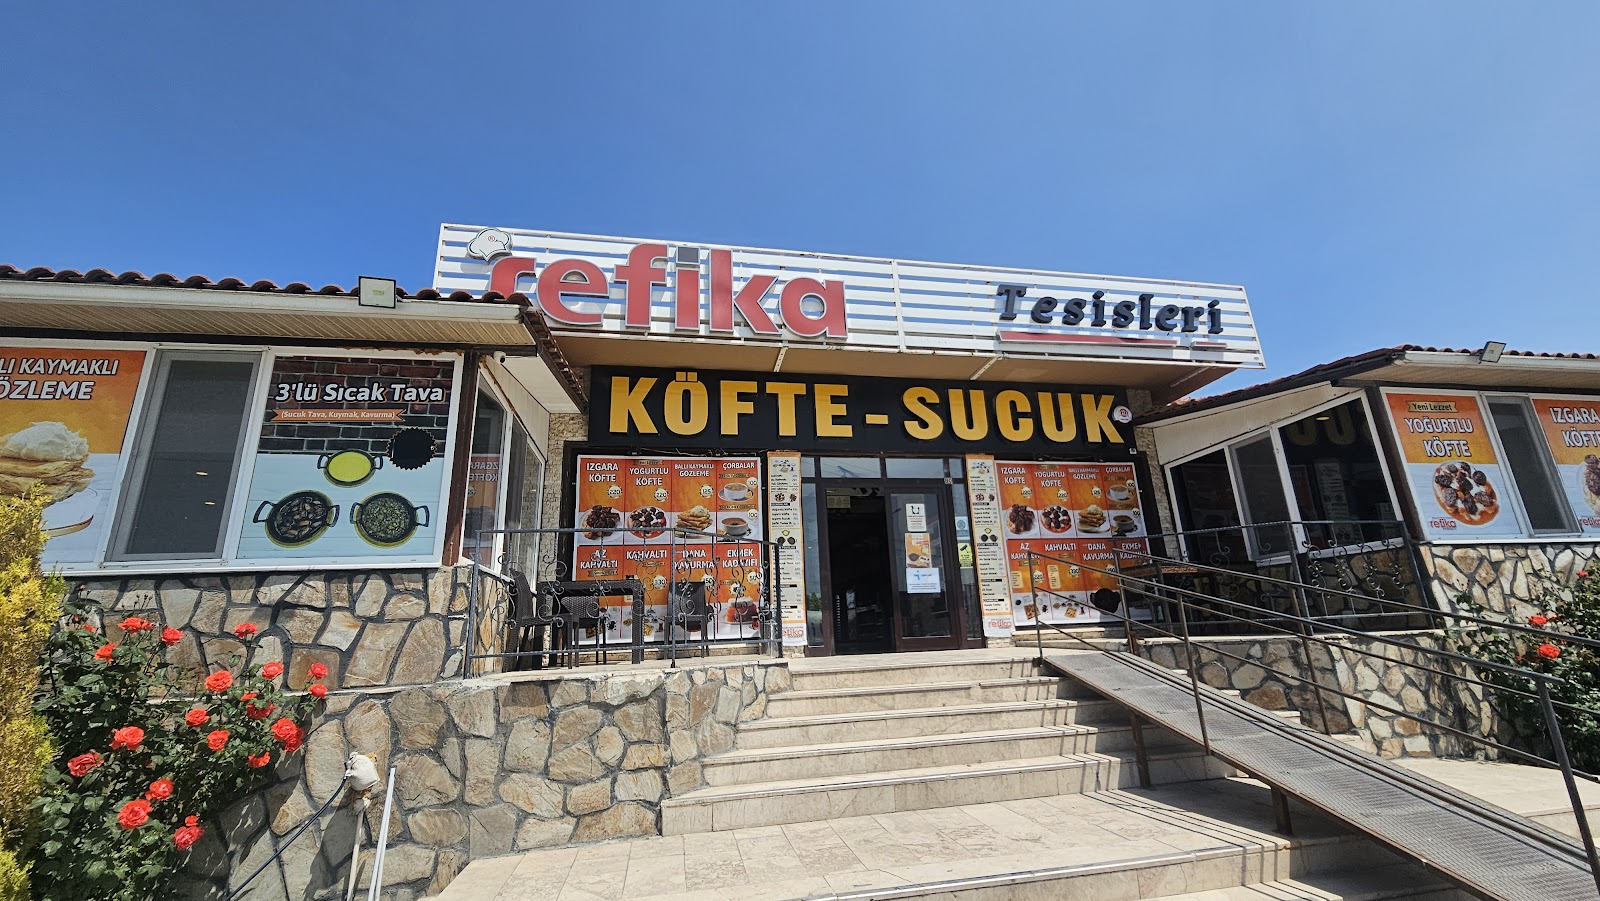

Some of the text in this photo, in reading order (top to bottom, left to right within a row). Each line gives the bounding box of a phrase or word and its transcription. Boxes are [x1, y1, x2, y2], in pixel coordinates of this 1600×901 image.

[489, 243, 848, 338] refika
[997, 284, 1224, 334] Tesisleri
[18, 358, 119, 375] KAYMAKLI
[275, 381, 444, 402] 3'lü Sıcak Tava
[609, 371, 854, 438] KÖFTE
[902, 386, 1125, 444] SUCUK
[1411, 402, 1452, 411] Yeni Lezzet
[281, 411, 396, 420] (Sucuk Tava, Kuymak, Kavurma)
[1549, 407, 1600, 423] IZGARA
[1404, 416, 1474, 433] YOĞURTLU
[1423, 436, 1472, 457] KÖFTE
[587, 463, 618, 471] IZGARA
[722, 462, 755, 470] ÇORBALAR
[589, 472, 616, 482] KÖFTE
[1020, 542, 1030, 550] AZ
[1045, 543, 1077, 551] KAHVALTI
[626, 550, 667, 560] KAHVALTI
[682, 549, 706, 558] DANA
[1083, 552, 1114, 560] KAVURMA
